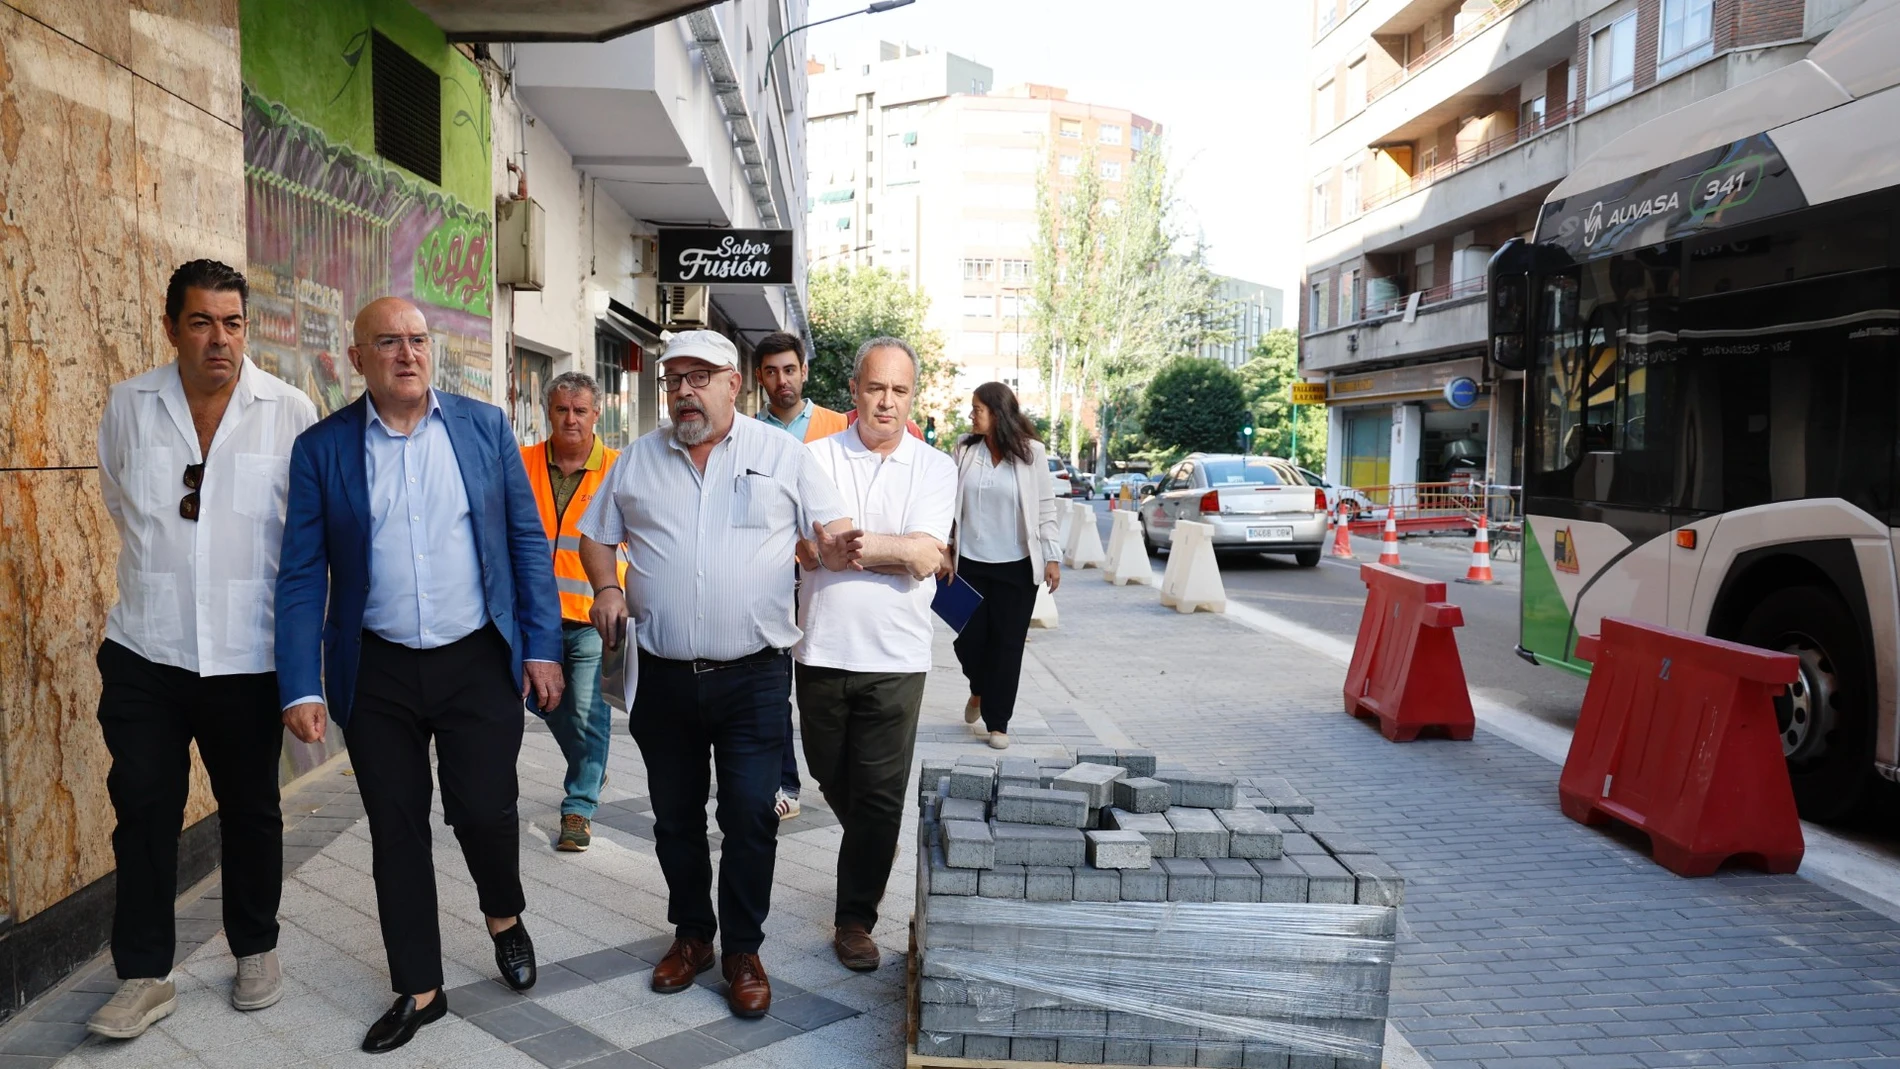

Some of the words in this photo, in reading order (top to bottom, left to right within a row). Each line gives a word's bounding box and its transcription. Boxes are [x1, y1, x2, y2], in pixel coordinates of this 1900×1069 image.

[1703, 171, 1746, 201] 341
[1606, 191, 1679, 228] AUVASA
[717, 235, 771, 257] Sabor
[417, 229, 492, 311] Vegg
[678, 248, 771, 280] Fusión
